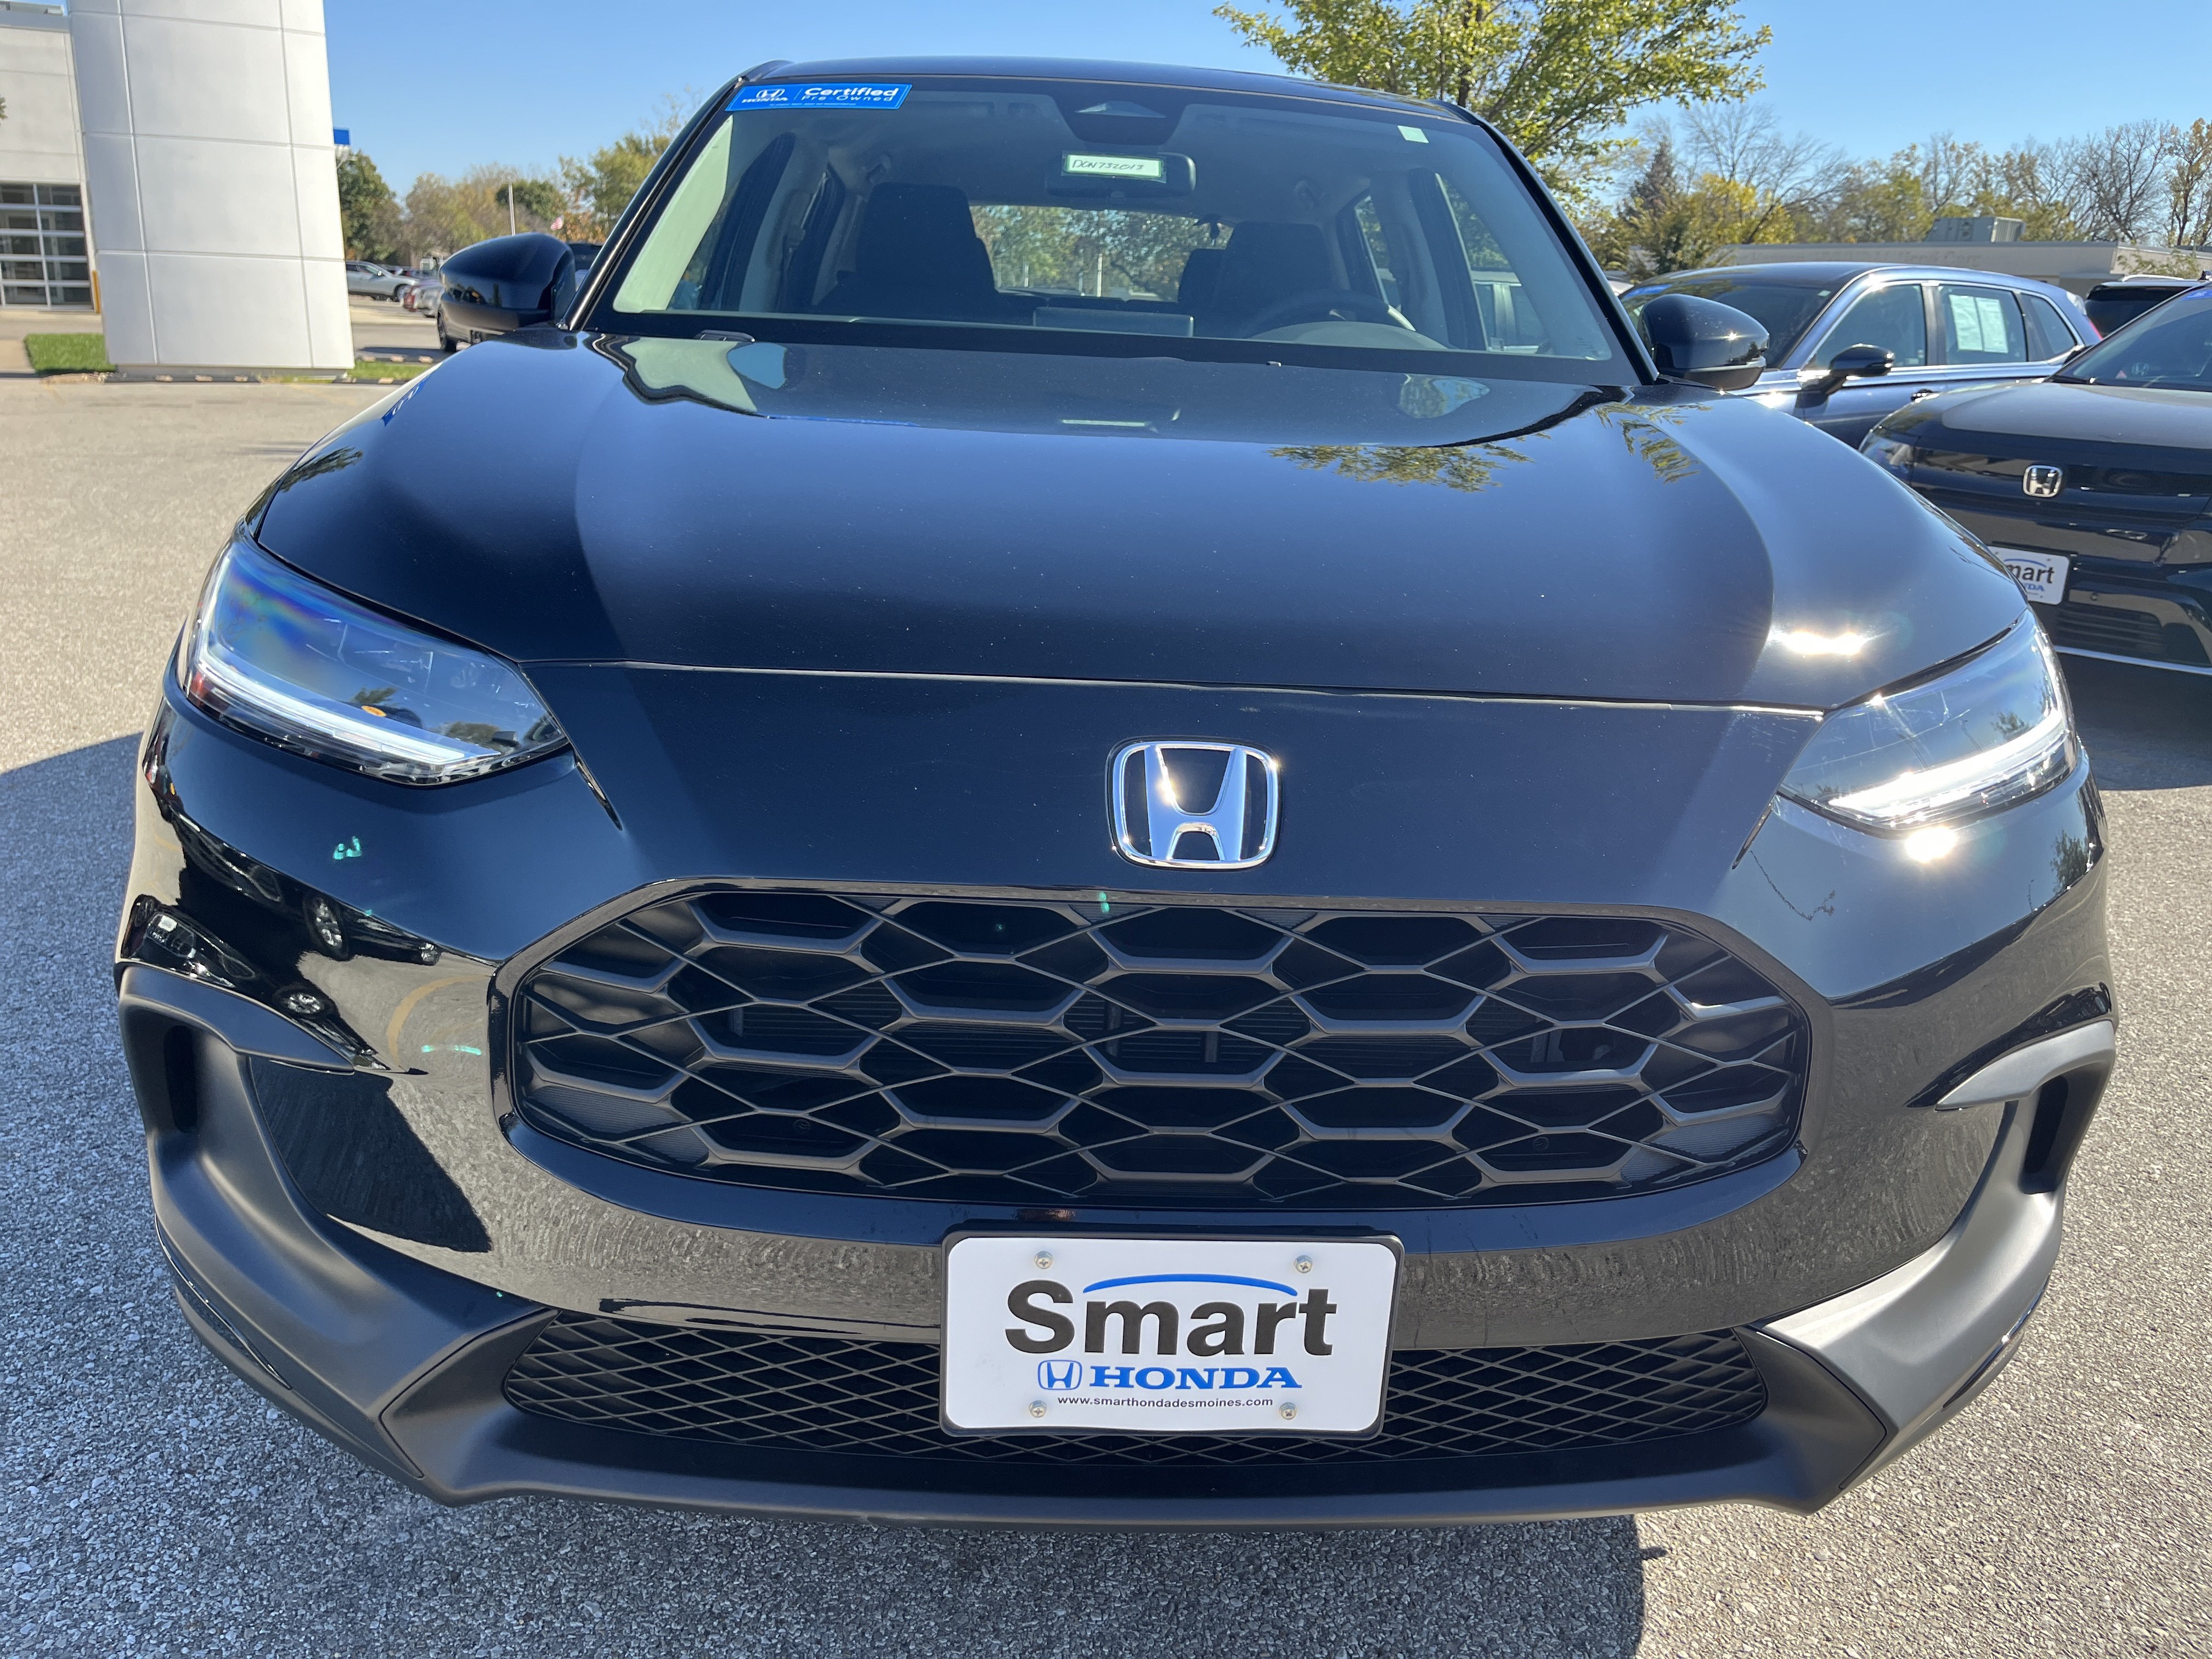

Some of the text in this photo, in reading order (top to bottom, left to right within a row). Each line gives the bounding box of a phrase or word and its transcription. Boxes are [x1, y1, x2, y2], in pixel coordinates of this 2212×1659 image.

[804, 87, 899, 97] Certified
[2005, 564, 2055, 584] mart
[1005, 1278, 1338, 1357] Smart
[1089, 1365, 1302, 1390] HONDA
[1057, 1396, 1273, 1408] www.smarthondadesmoines.com
